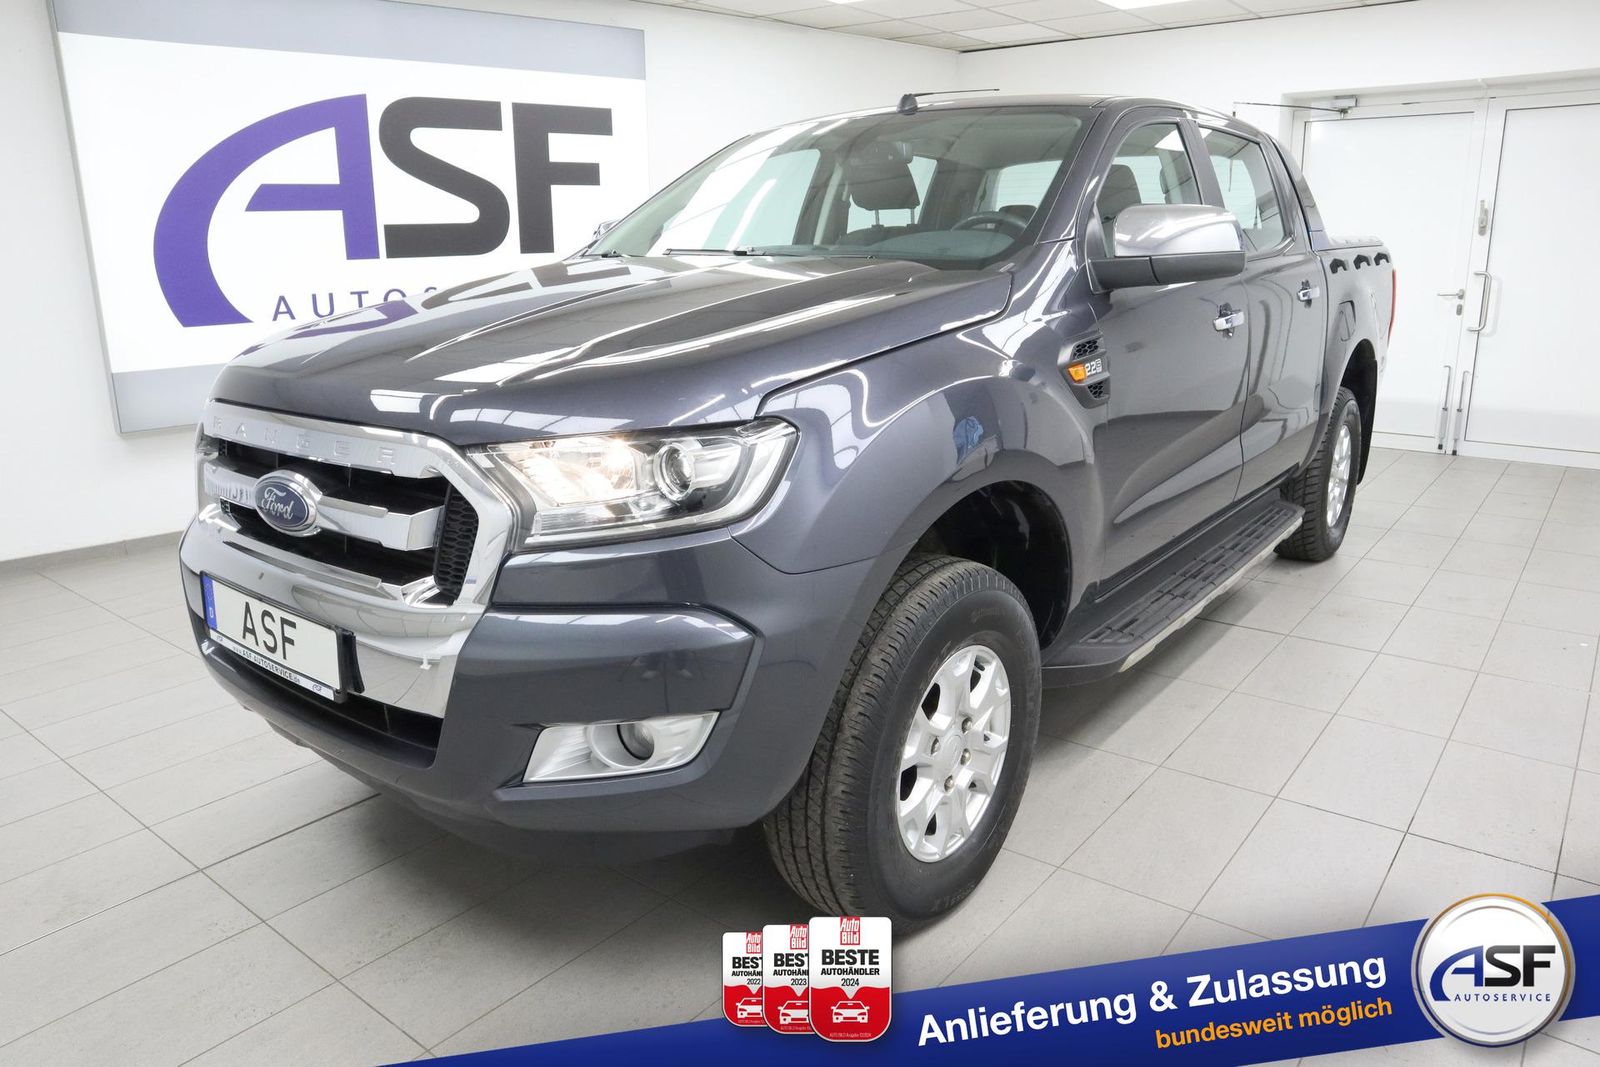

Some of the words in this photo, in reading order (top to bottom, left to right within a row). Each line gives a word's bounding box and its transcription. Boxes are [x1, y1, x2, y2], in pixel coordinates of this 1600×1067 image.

[153, 93, 613, 327] ASF
[213, 415, 396, 465] RANGER
[261, 486, 294, 520] Ford
[242, 601, 297, 660] ASF
